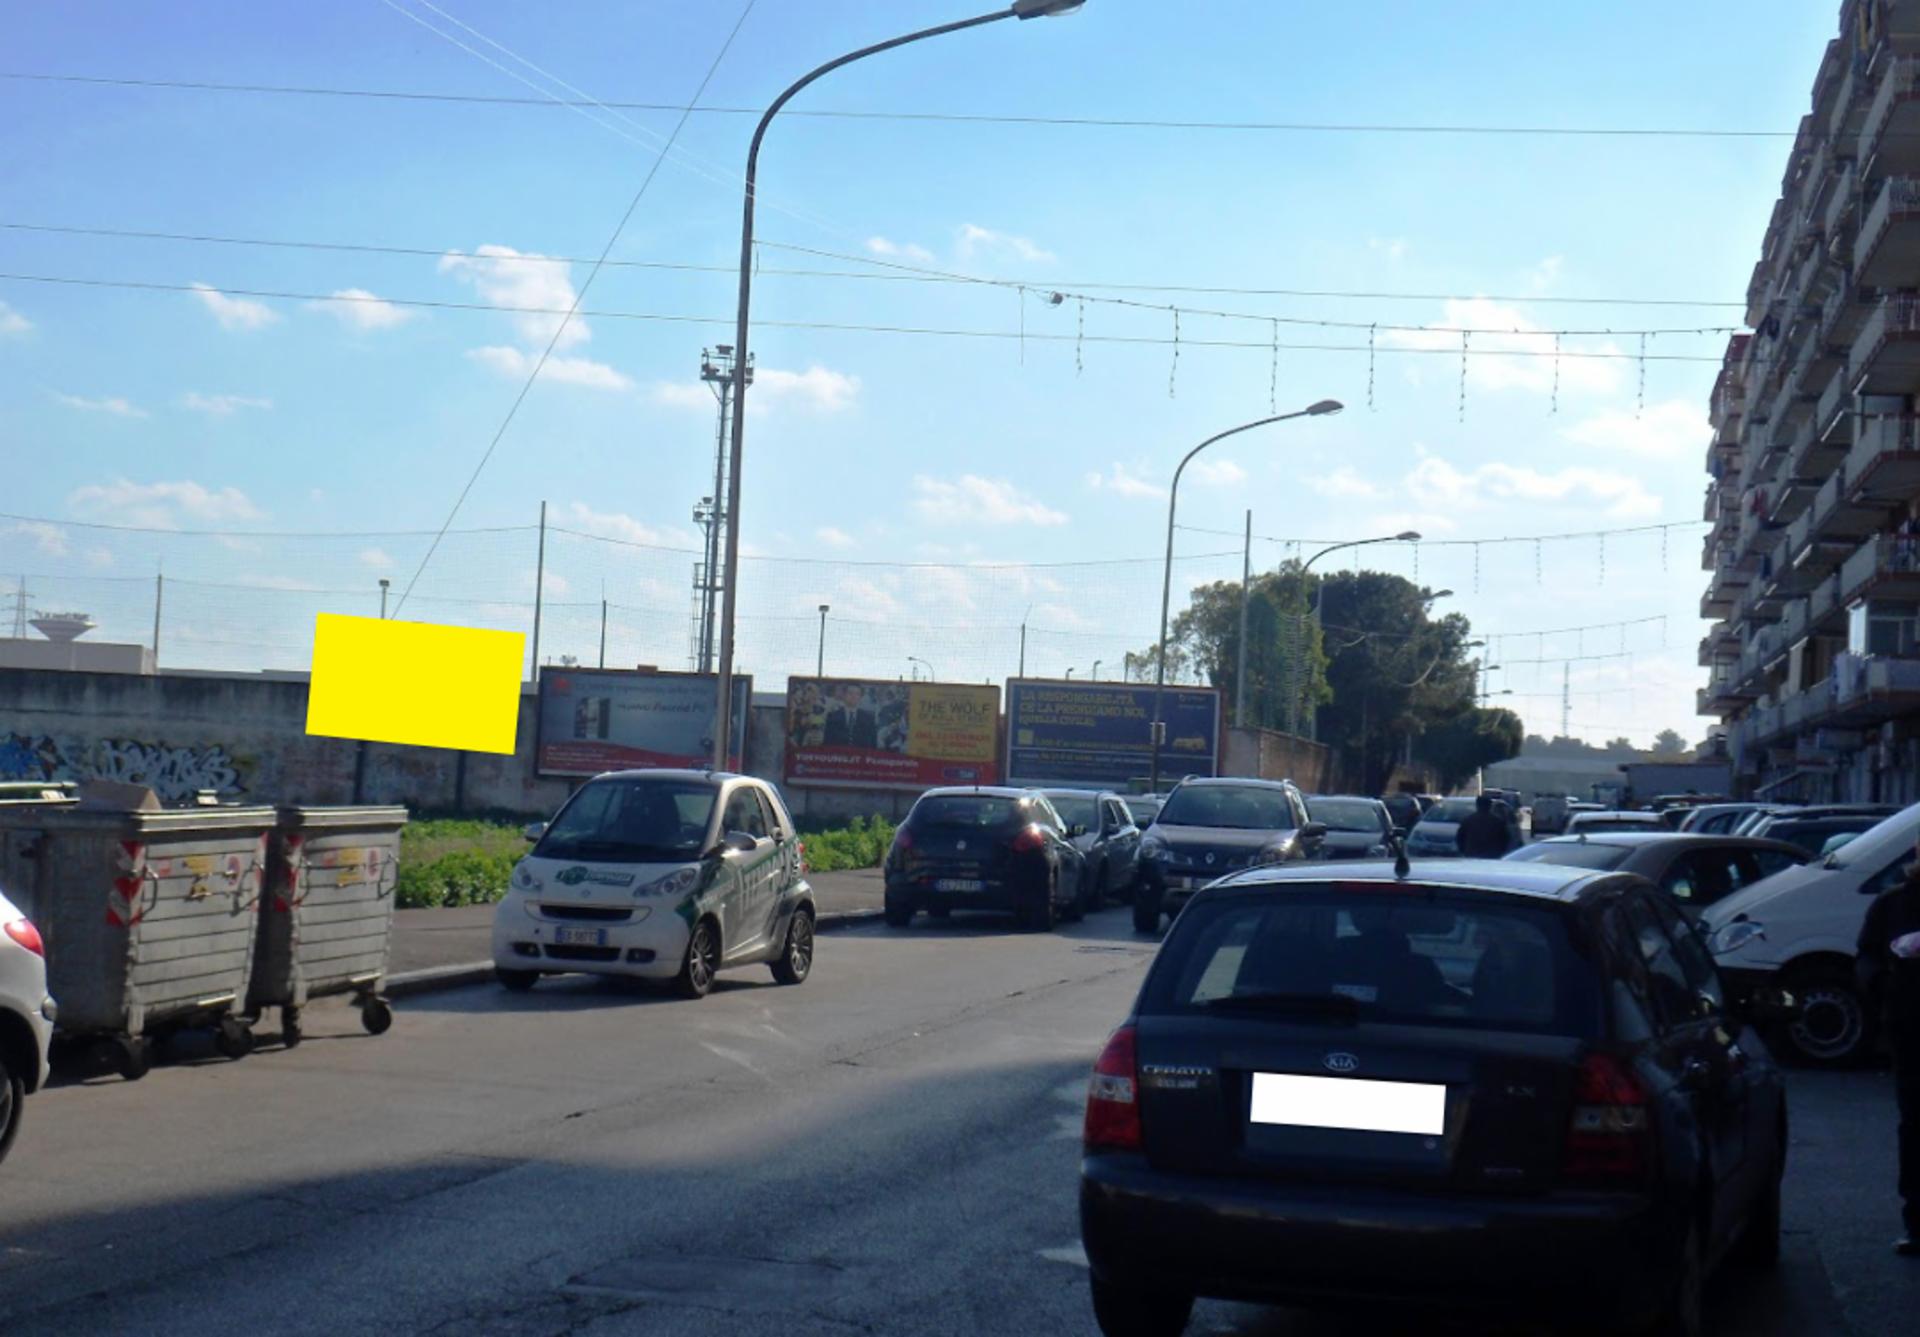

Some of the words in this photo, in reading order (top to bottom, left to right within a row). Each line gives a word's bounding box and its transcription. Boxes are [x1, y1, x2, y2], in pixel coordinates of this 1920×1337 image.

[919, 700, 945, 713] THE
[950, 702, 992, 715] WOLF
[1328, 1055, 1355, 1068] KIA
